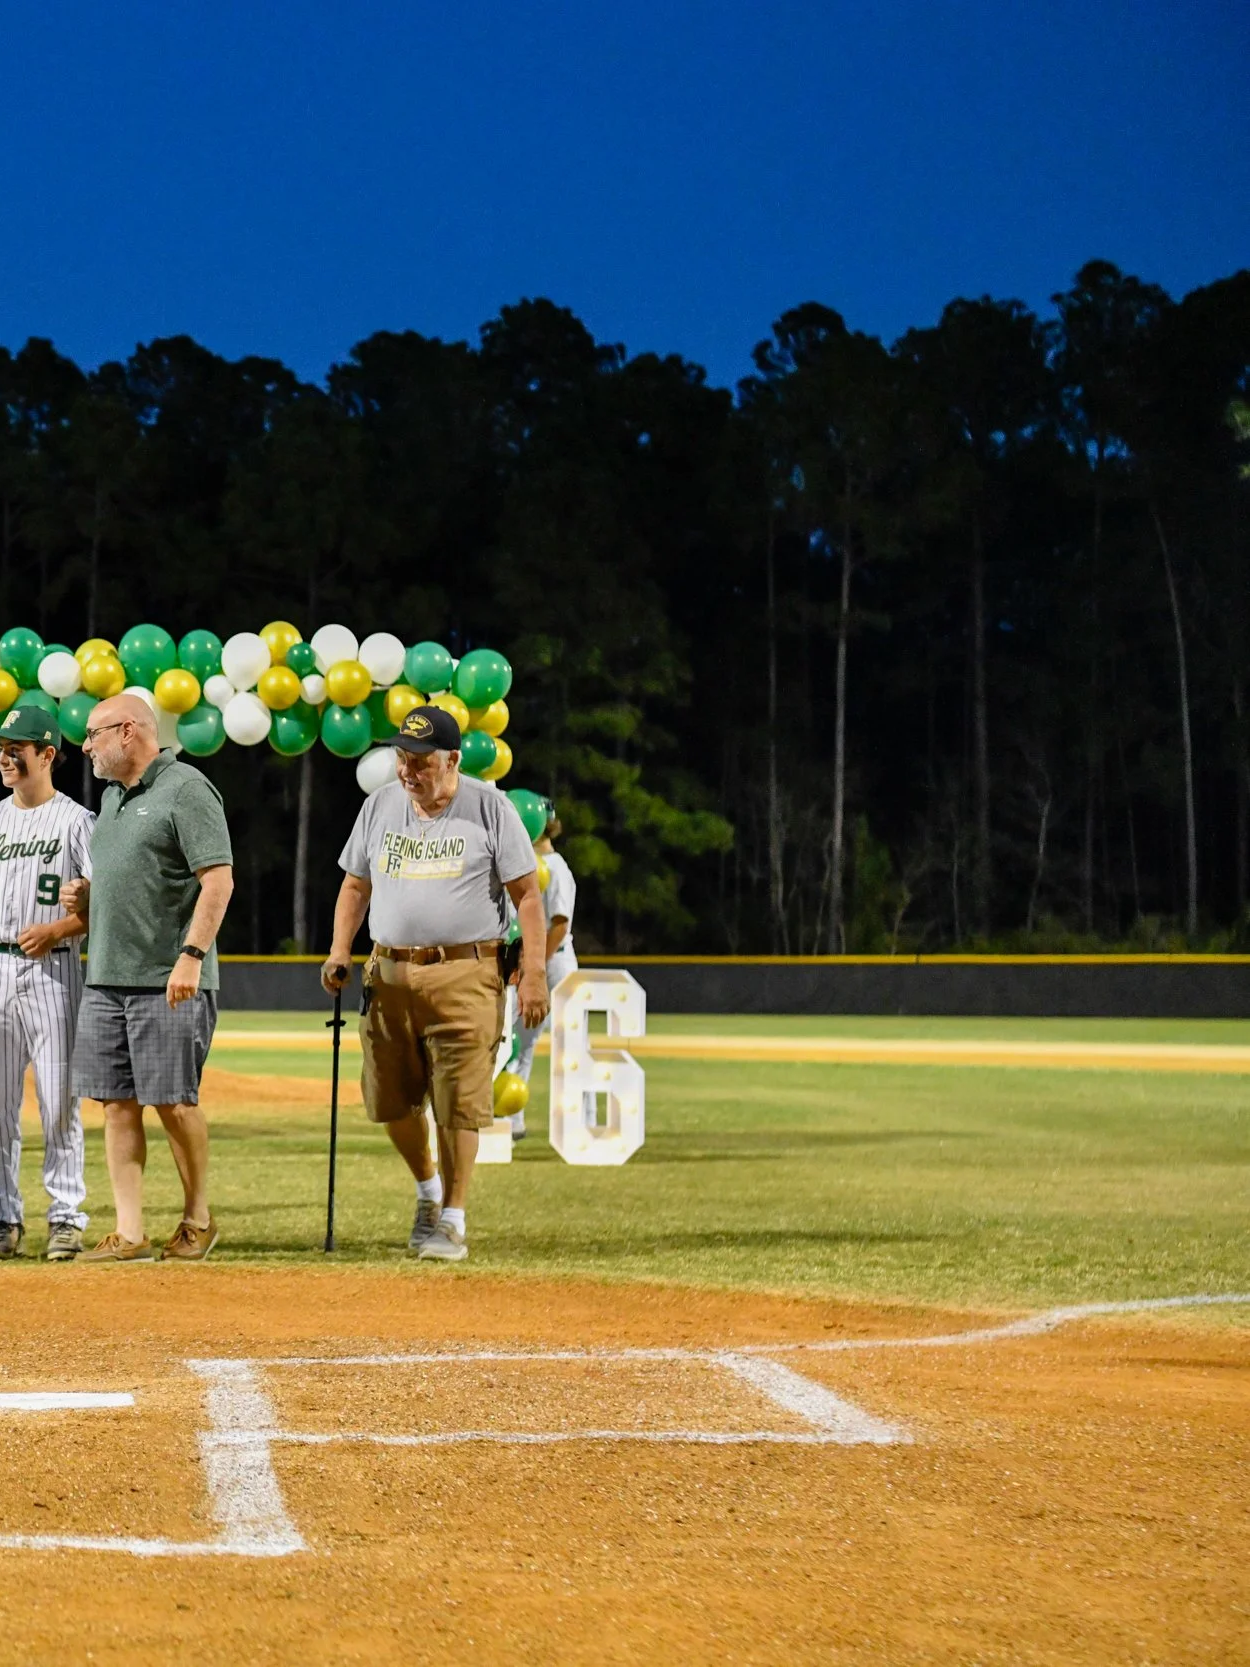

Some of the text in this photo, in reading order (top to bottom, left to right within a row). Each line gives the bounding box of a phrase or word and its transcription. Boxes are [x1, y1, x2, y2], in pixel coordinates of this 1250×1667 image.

[382, 832, 465, 860] FLEMING ISLAND
[37, 873, 61, 906] 9
[549, 969, 646, 1166] 6
